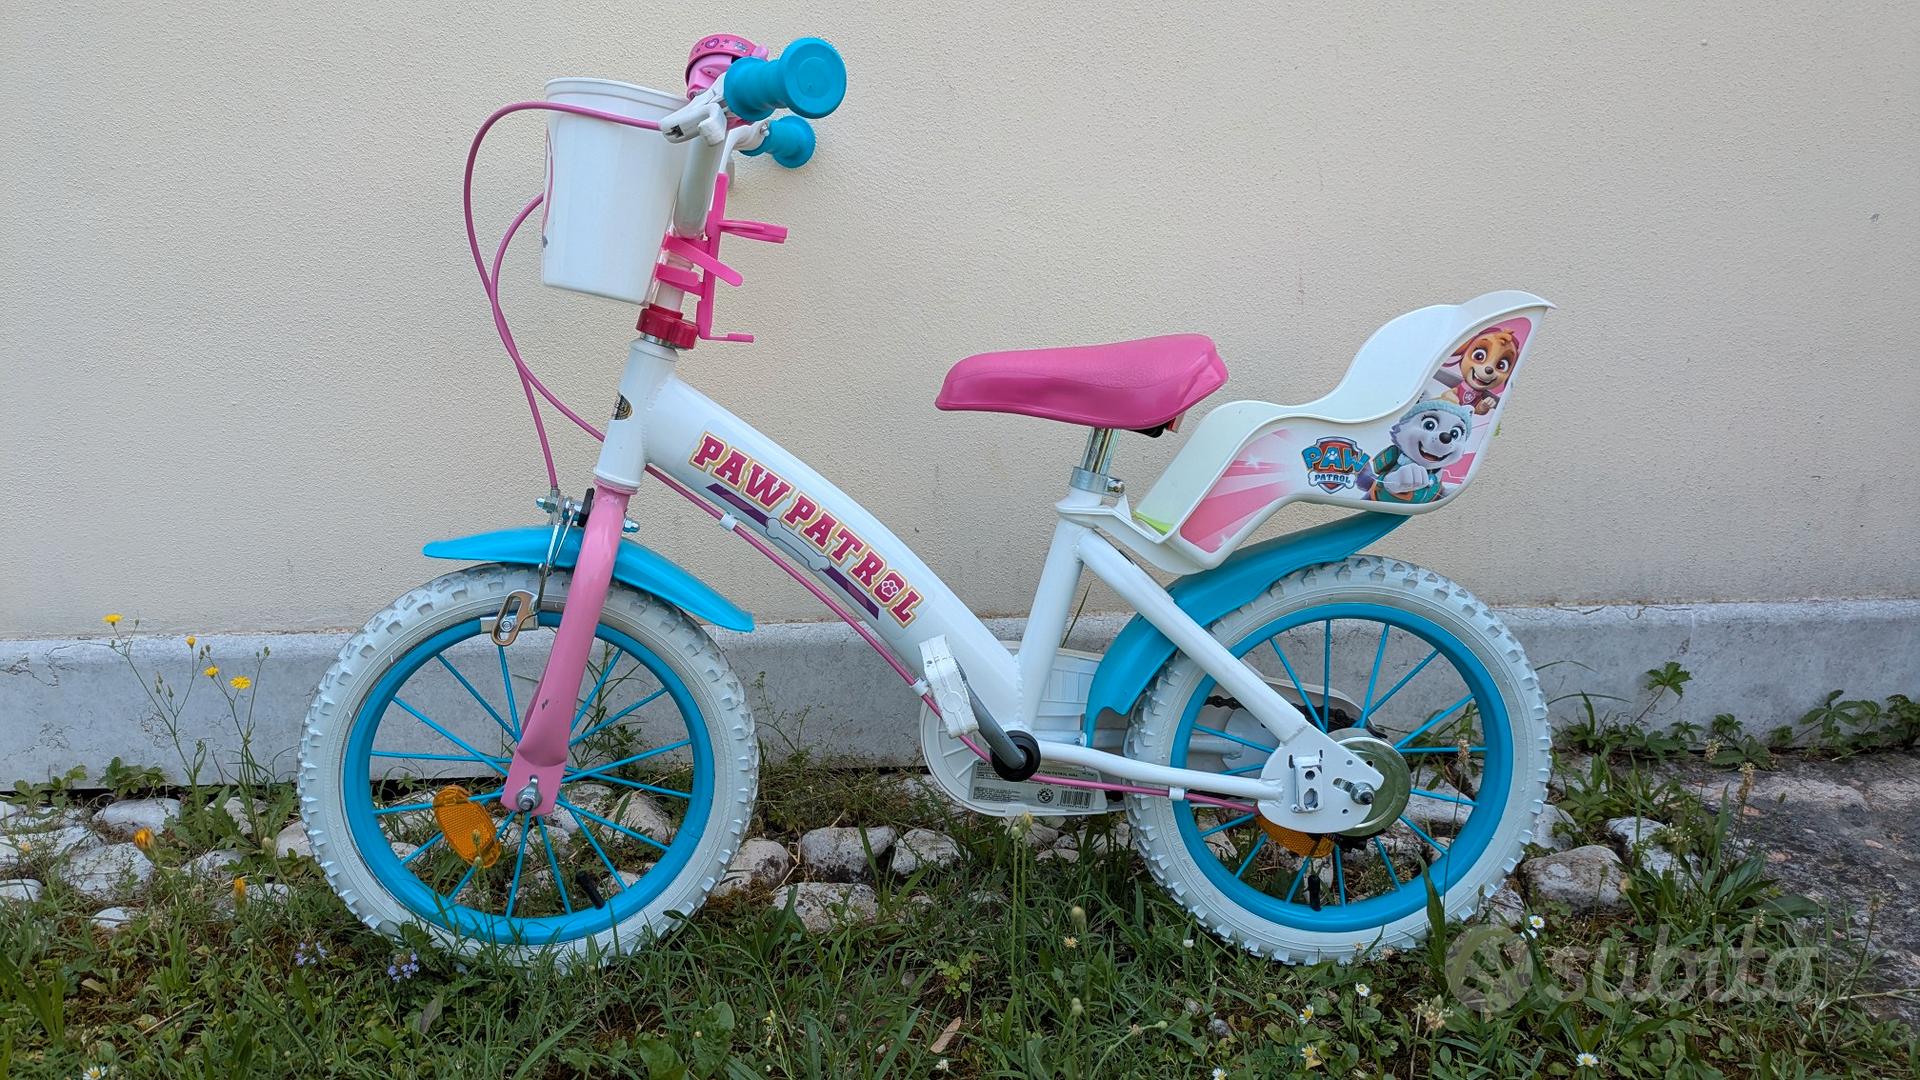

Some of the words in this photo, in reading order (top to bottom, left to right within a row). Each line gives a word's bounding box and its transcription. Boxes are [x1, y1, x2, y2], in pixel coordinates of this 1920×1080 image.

[1302, 446, 1370, 473] PAW
[1314, 473, 1351, 484] PATROL
[690, 432, 794, 511] PAW
[781, 490, 925, 628] PATROL
